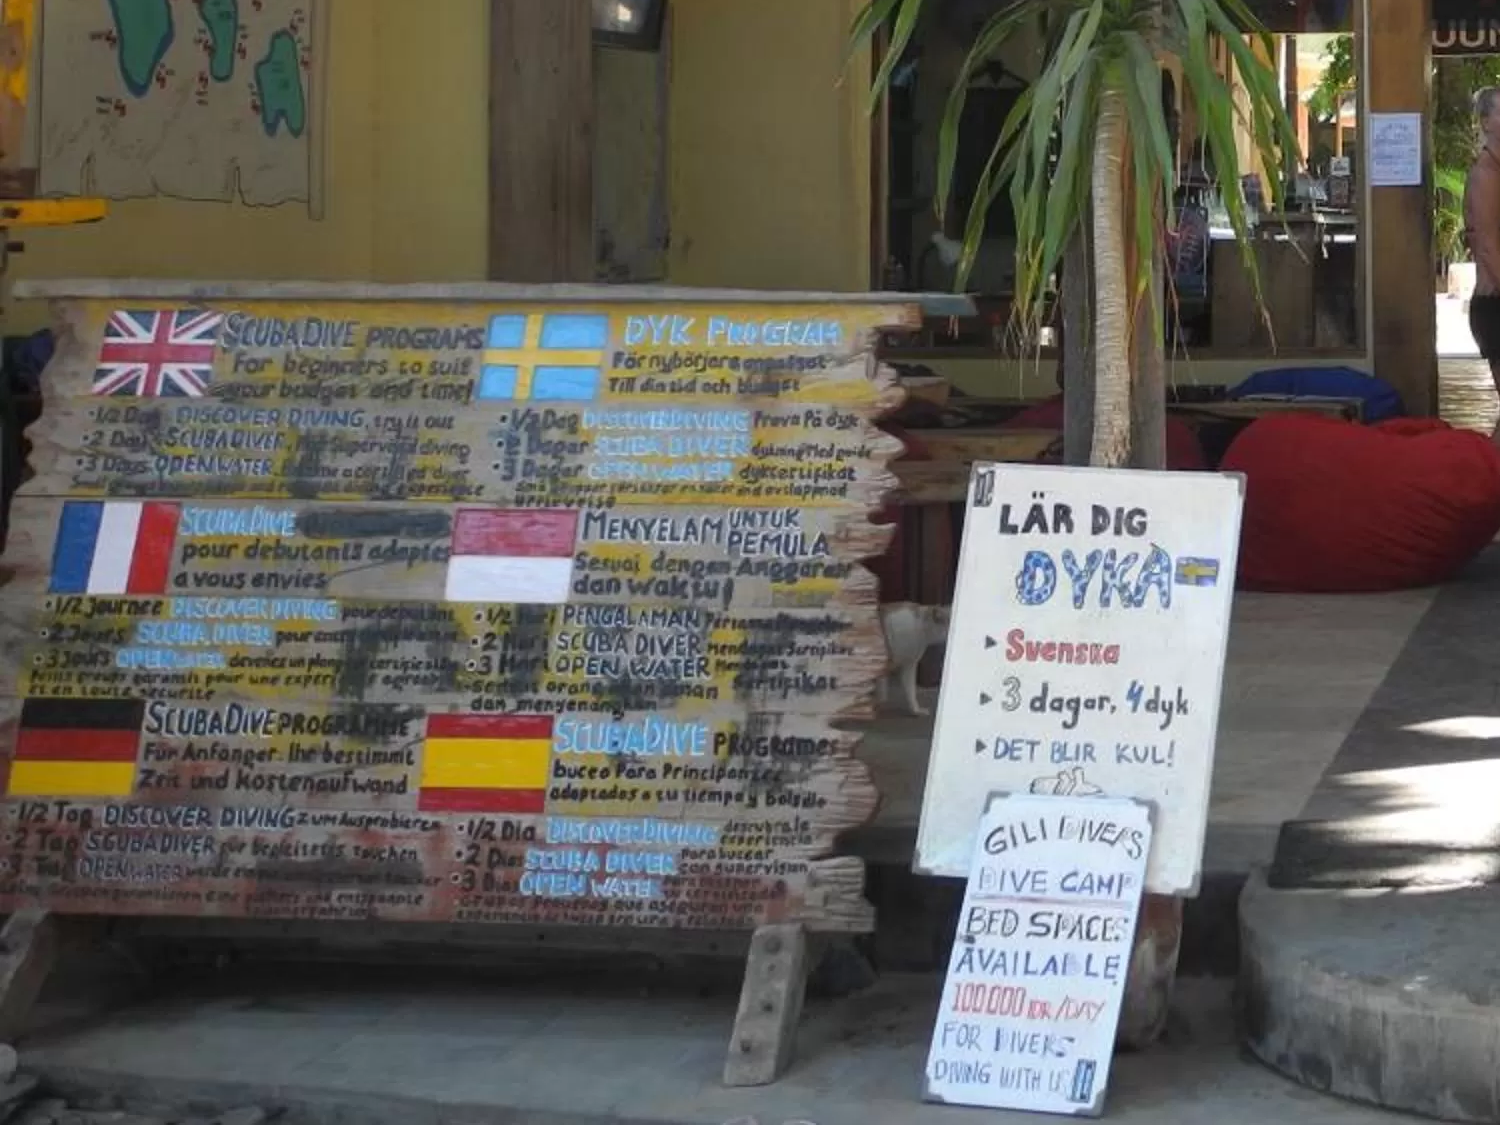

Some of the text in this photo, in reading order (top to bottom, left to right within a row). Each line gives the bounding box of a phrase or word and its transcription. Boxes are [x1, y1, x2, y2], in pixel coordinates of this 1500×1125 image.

[624, 315, 696, 346] DYK
[233, 354, 273, 373] For
[284, 353, 388, 379] beginners
[428, 356, 473, 375] suit
[175, 407, 280, 425] DISCOVER
[728, 508, 800, 529] UNTUK
[999, 491, 1148, 536] LÄR DIG
[583, 510, 722, 544] MENYELAM
[182, 542, 239, 566] pour
[727, 530, 831, 558] PEMULA
[194, 569, 328, 590] vous envies
[574, 574, 621, 595] dan
[1015, 545, 1172, 609] DYKA
[563, 606, 700, 628] PENGALAMAN
[482, 632, 497, 651] 2
[557, 632, 629, 652] SCUBA
[635, 634, 701, 655] DIVER
[1005, 628, 1121, 665] Svenska
[479, 655, 492, 675] 3
[556, 655, 621, 677] OPEN
[630, 659, 710, 680] WATER
[1001, 676, 1021, 712] 3
[144, 741, 415, 766] Für bestimmt
[993, 738, 1176, 766] DET BLIR KUL!
[553, 759, 611, 780] buceo
[18, 800, 296, 830] 1/2 Tag DISCOVER DIVING
[15, 827, 27, 848] 2
[162, 834, 215, 854] DIVER
[468, 817, 497, 842] 1/2
[984, 816, 1143, 859] GILI DIVERS
[464, 844, 481, 866] 2
[462, 869, 475, 891] 3
[978, 866, 1136, 898] DIVE CAMP
[966, 906, 1128, 942] BED SPACES
[954, 947, 1121, 979] AVAILABLE
[942, 1023, 982, 1051] FOR
[1000, 1066, 1041, 1091] WITH
